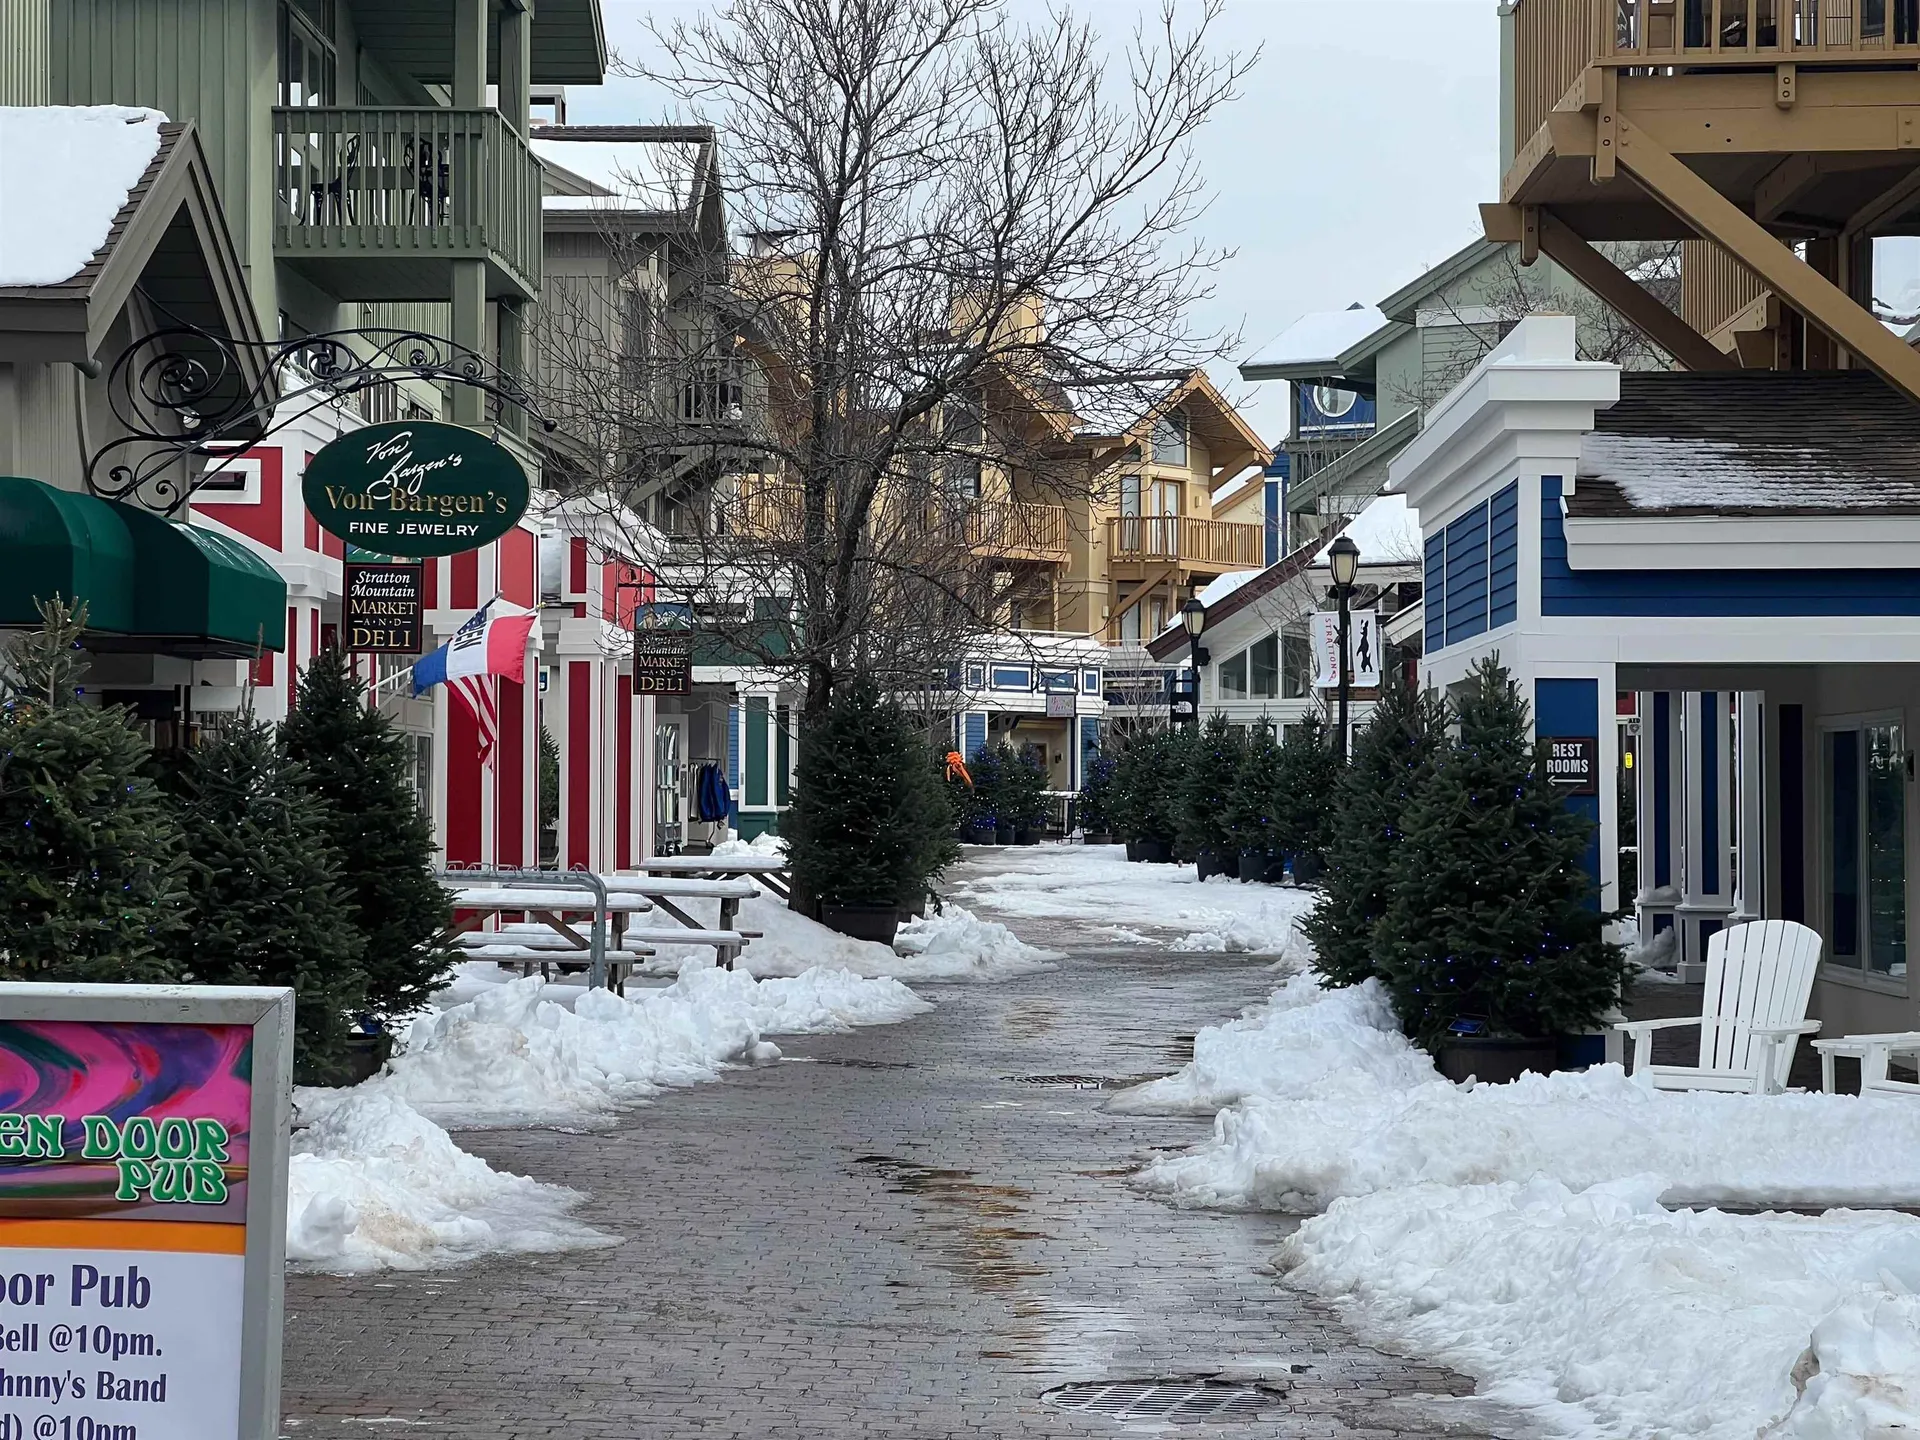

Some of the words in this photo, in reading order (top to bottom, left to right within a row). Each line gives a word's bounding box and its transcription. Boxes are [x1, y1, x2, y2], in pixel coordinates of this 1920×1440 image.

[324, 485, 375, 511] Von
[388, 487, 508, 517] Bargen's
[349, 521, 389, 535] FINE
[396, 522, 480, 537] JEWELRY
[355, 570, 411, 585] Stratton
[350, 584, 416, 599] Mountain
[350, 599, 418, 616] MARKET
[351, 627, 412, 648] DELI
[1325, 617, 1338, 670] STRATTON
[640, 676, 684, 691] DELI
[1552, 743, 1583, 758] REST
[1546, 758, 1589, 774] ROOMS
[80, 1114, 230, 1163] DOOR
[114, 1158, 229, 1205] PUB
[70, 1264, 152, 1310] Pub
[48, 1323, 163, 1362] @10pm.
[96, 1370, 167, 1403] Band
